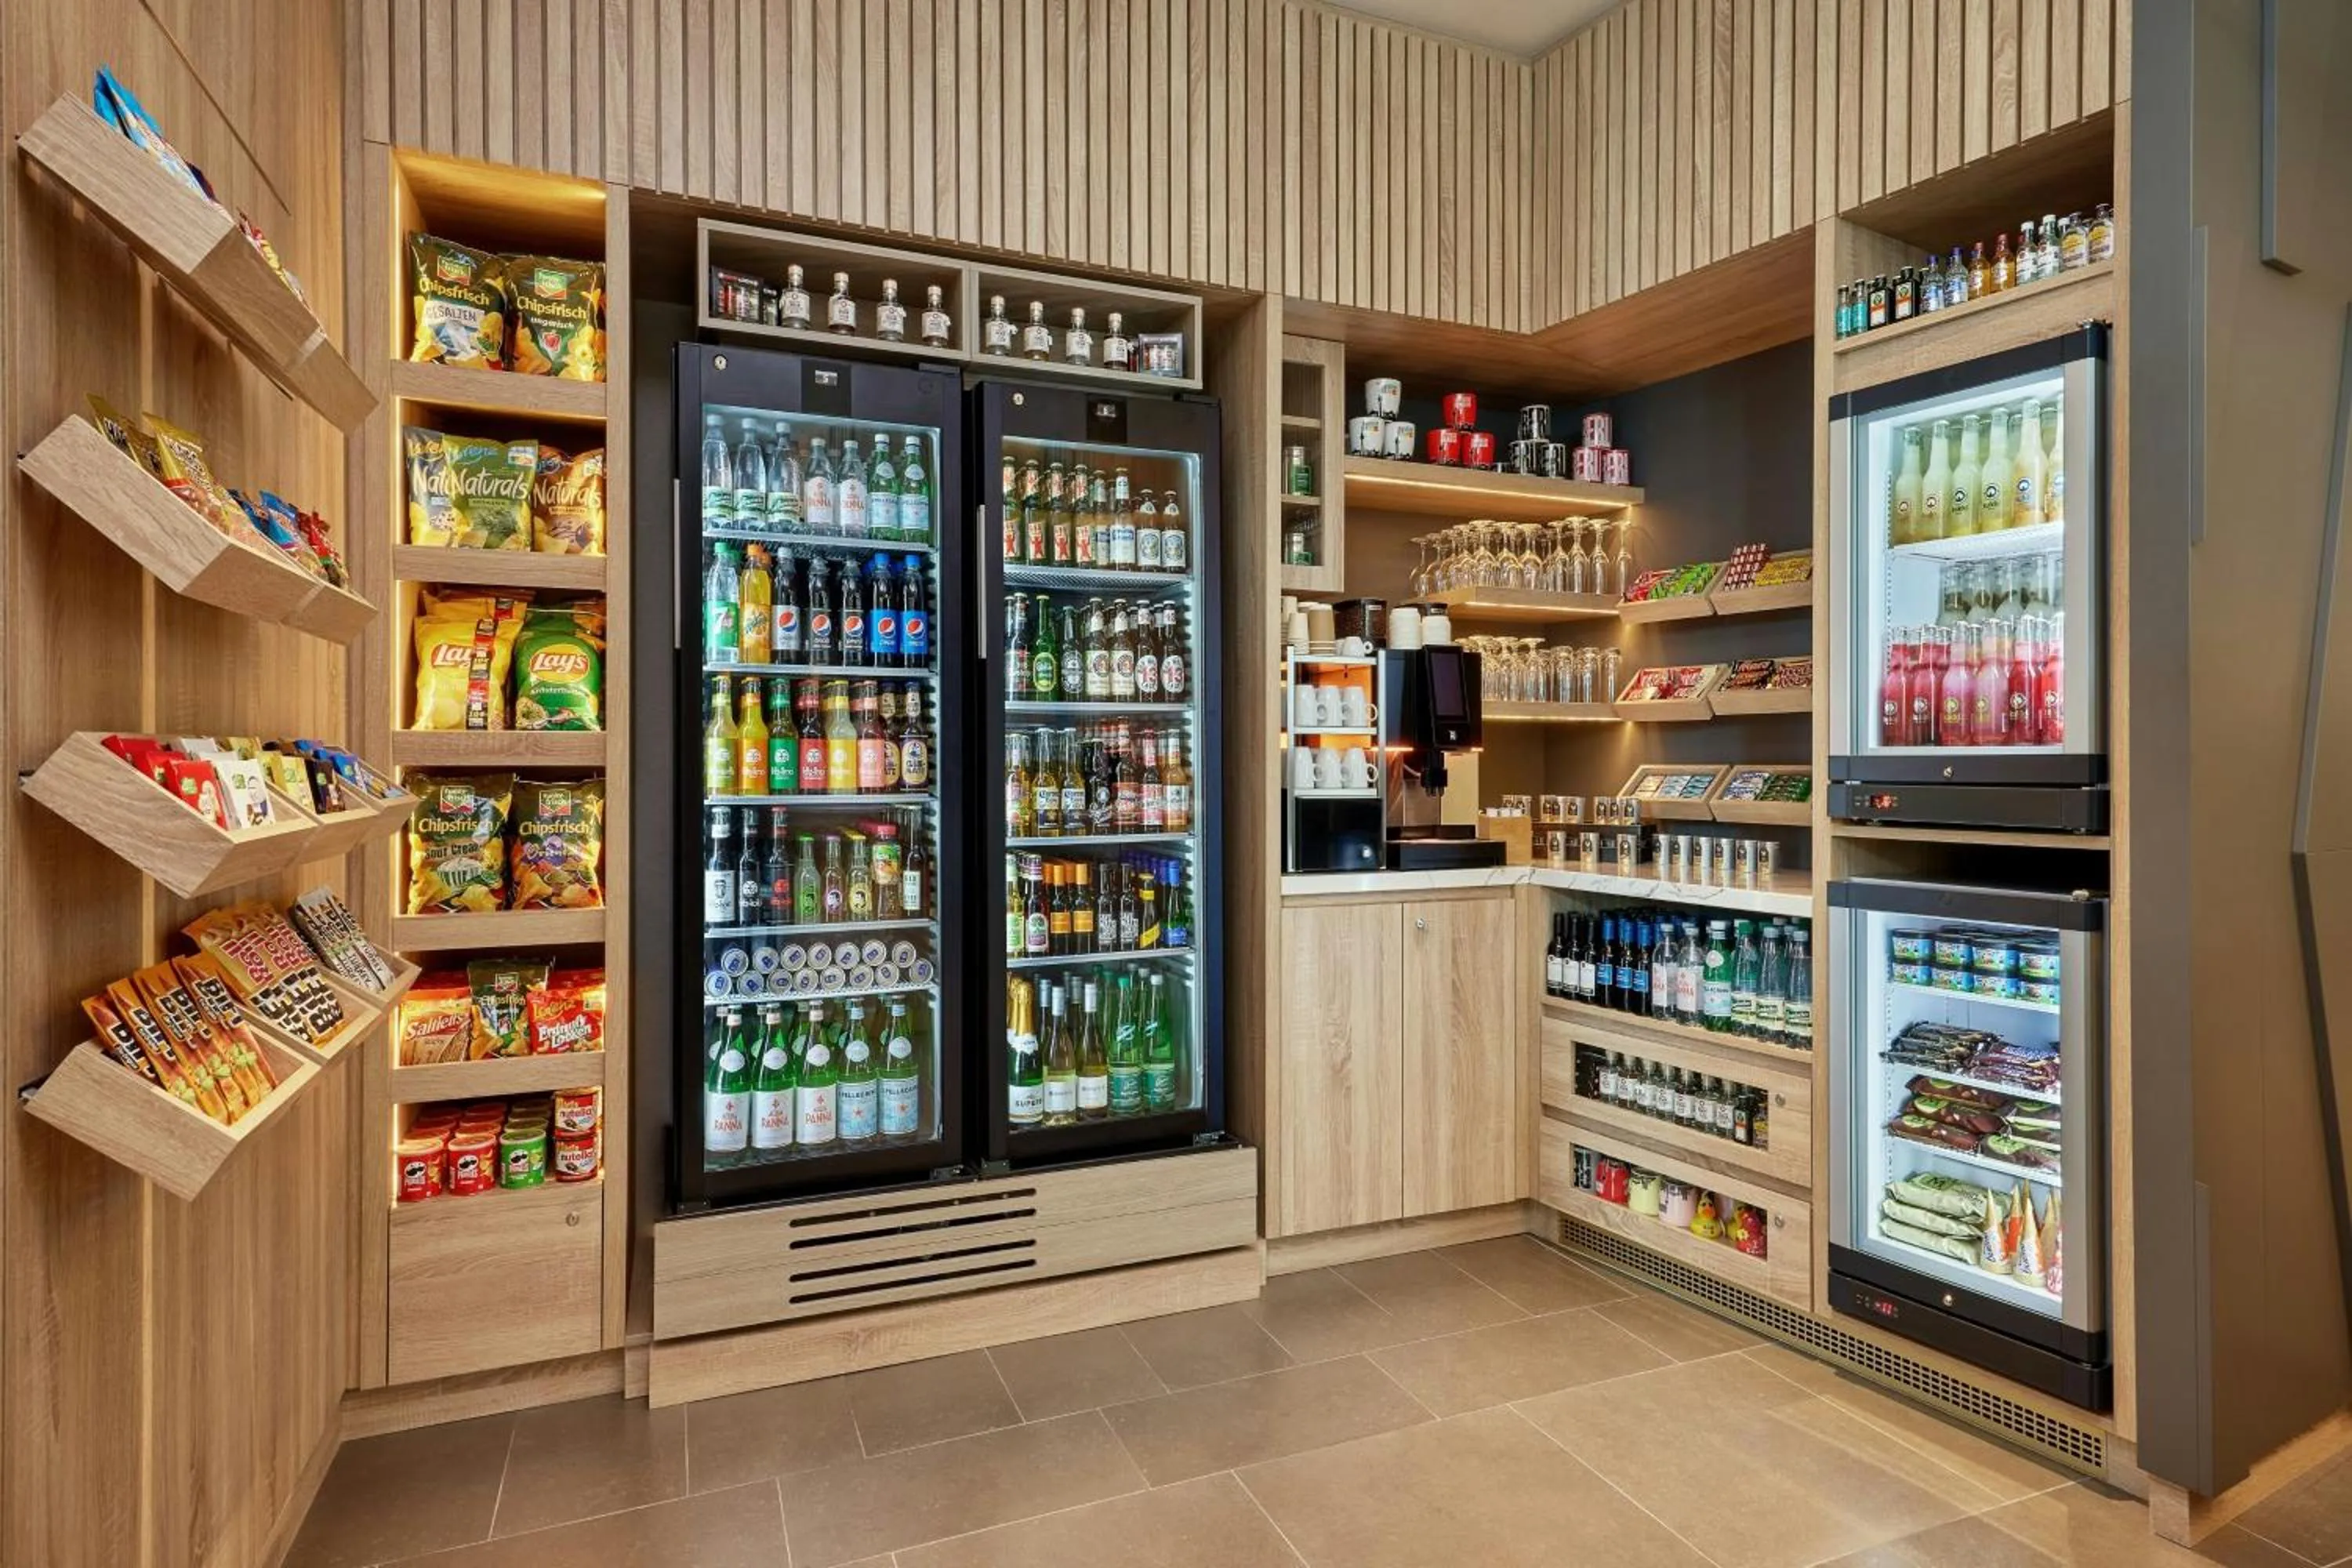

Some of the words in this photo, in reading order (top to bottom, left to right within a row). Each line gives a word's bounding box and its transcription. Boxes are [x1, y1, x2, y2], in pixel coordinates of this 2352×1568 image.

[517, 296, 586, 319] Chipsfrisch
[448, 466, 528, 500] Naturals
[534, 477, 602, 510] Naturals
[532, 652, 588, 673] Lay's
[520, 820, 590, 836] Chipsfrisch
